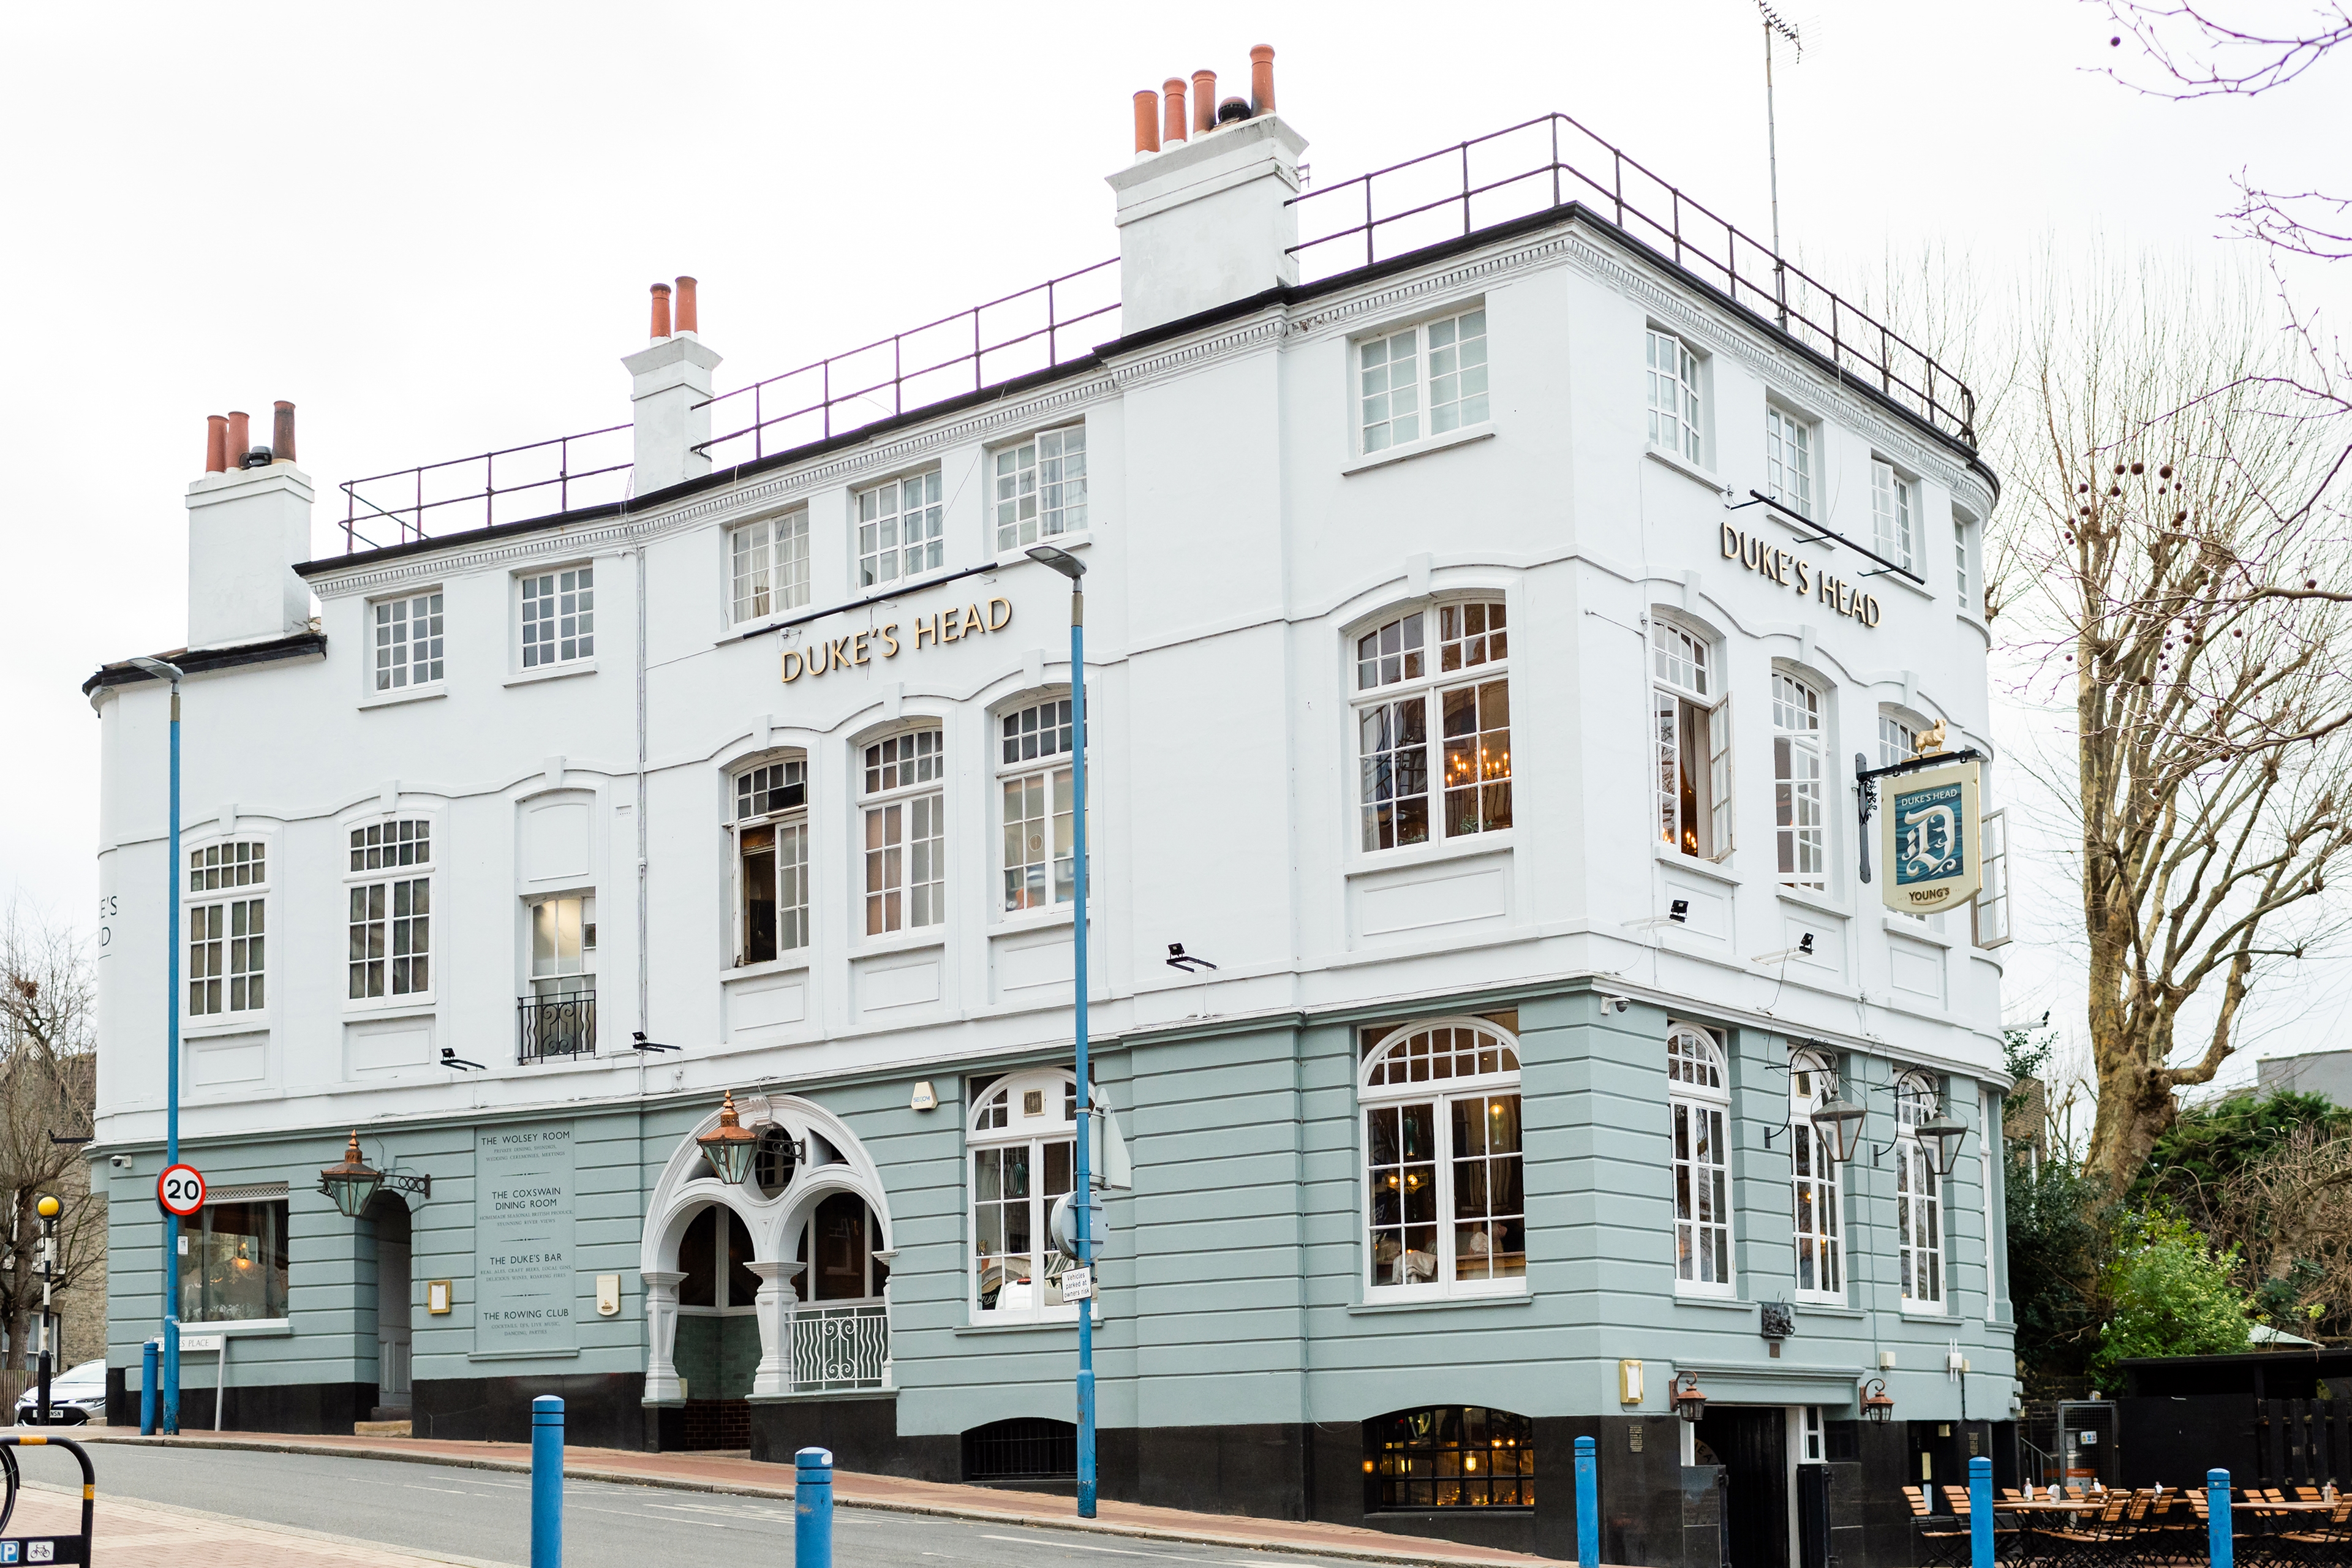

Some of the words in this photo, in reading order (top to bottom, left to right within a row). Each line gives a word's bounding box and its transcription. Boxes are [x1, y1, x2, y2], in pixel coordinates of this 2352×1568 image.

[1721, 522, 1811, 595] DUKE'S
[1818, 570, 1882, 628] HEAD
[782, 623, 900, 684] DUKE'S
[914, 597, 1012, 649] HEAD
[1901, 793, 1931, 807] DUKE'S
[1932, 788, 1958, 802] HEAD
[1909, 887, 1950, 901] YOUNG'S
[481, 1137, 497, 1145] THE
[503, 1134, 538, 1144] WOLSEY
[543, 1131, 570, 1140] ROOM
[167, 1179, 200, 1200] 20
[492, 1191, 508, 1199] THE
[513, 1187, 561, 1198] COXSWAIN
[496, 1201, 526, 1210] DINING
[530, 1199, 557, 1208] ROOM
[490, 1257, 505, 1265] THE
[510, 1254, 540, 1264] DUKE'S
[545, 1253, 562, 1262] BAR
[1066, 1272, 1085, 1281] Vehicles
[1066, 1281, 1081, 1291] parked
[1064, 1289, 1080, 1298] owners
[484, 1312, 499, 1321] THE
[504, 1310, 541, 1319] ROWING
[546, 1308, 568, 1317] CLUB
[4, 1544, 16, 1561] P
